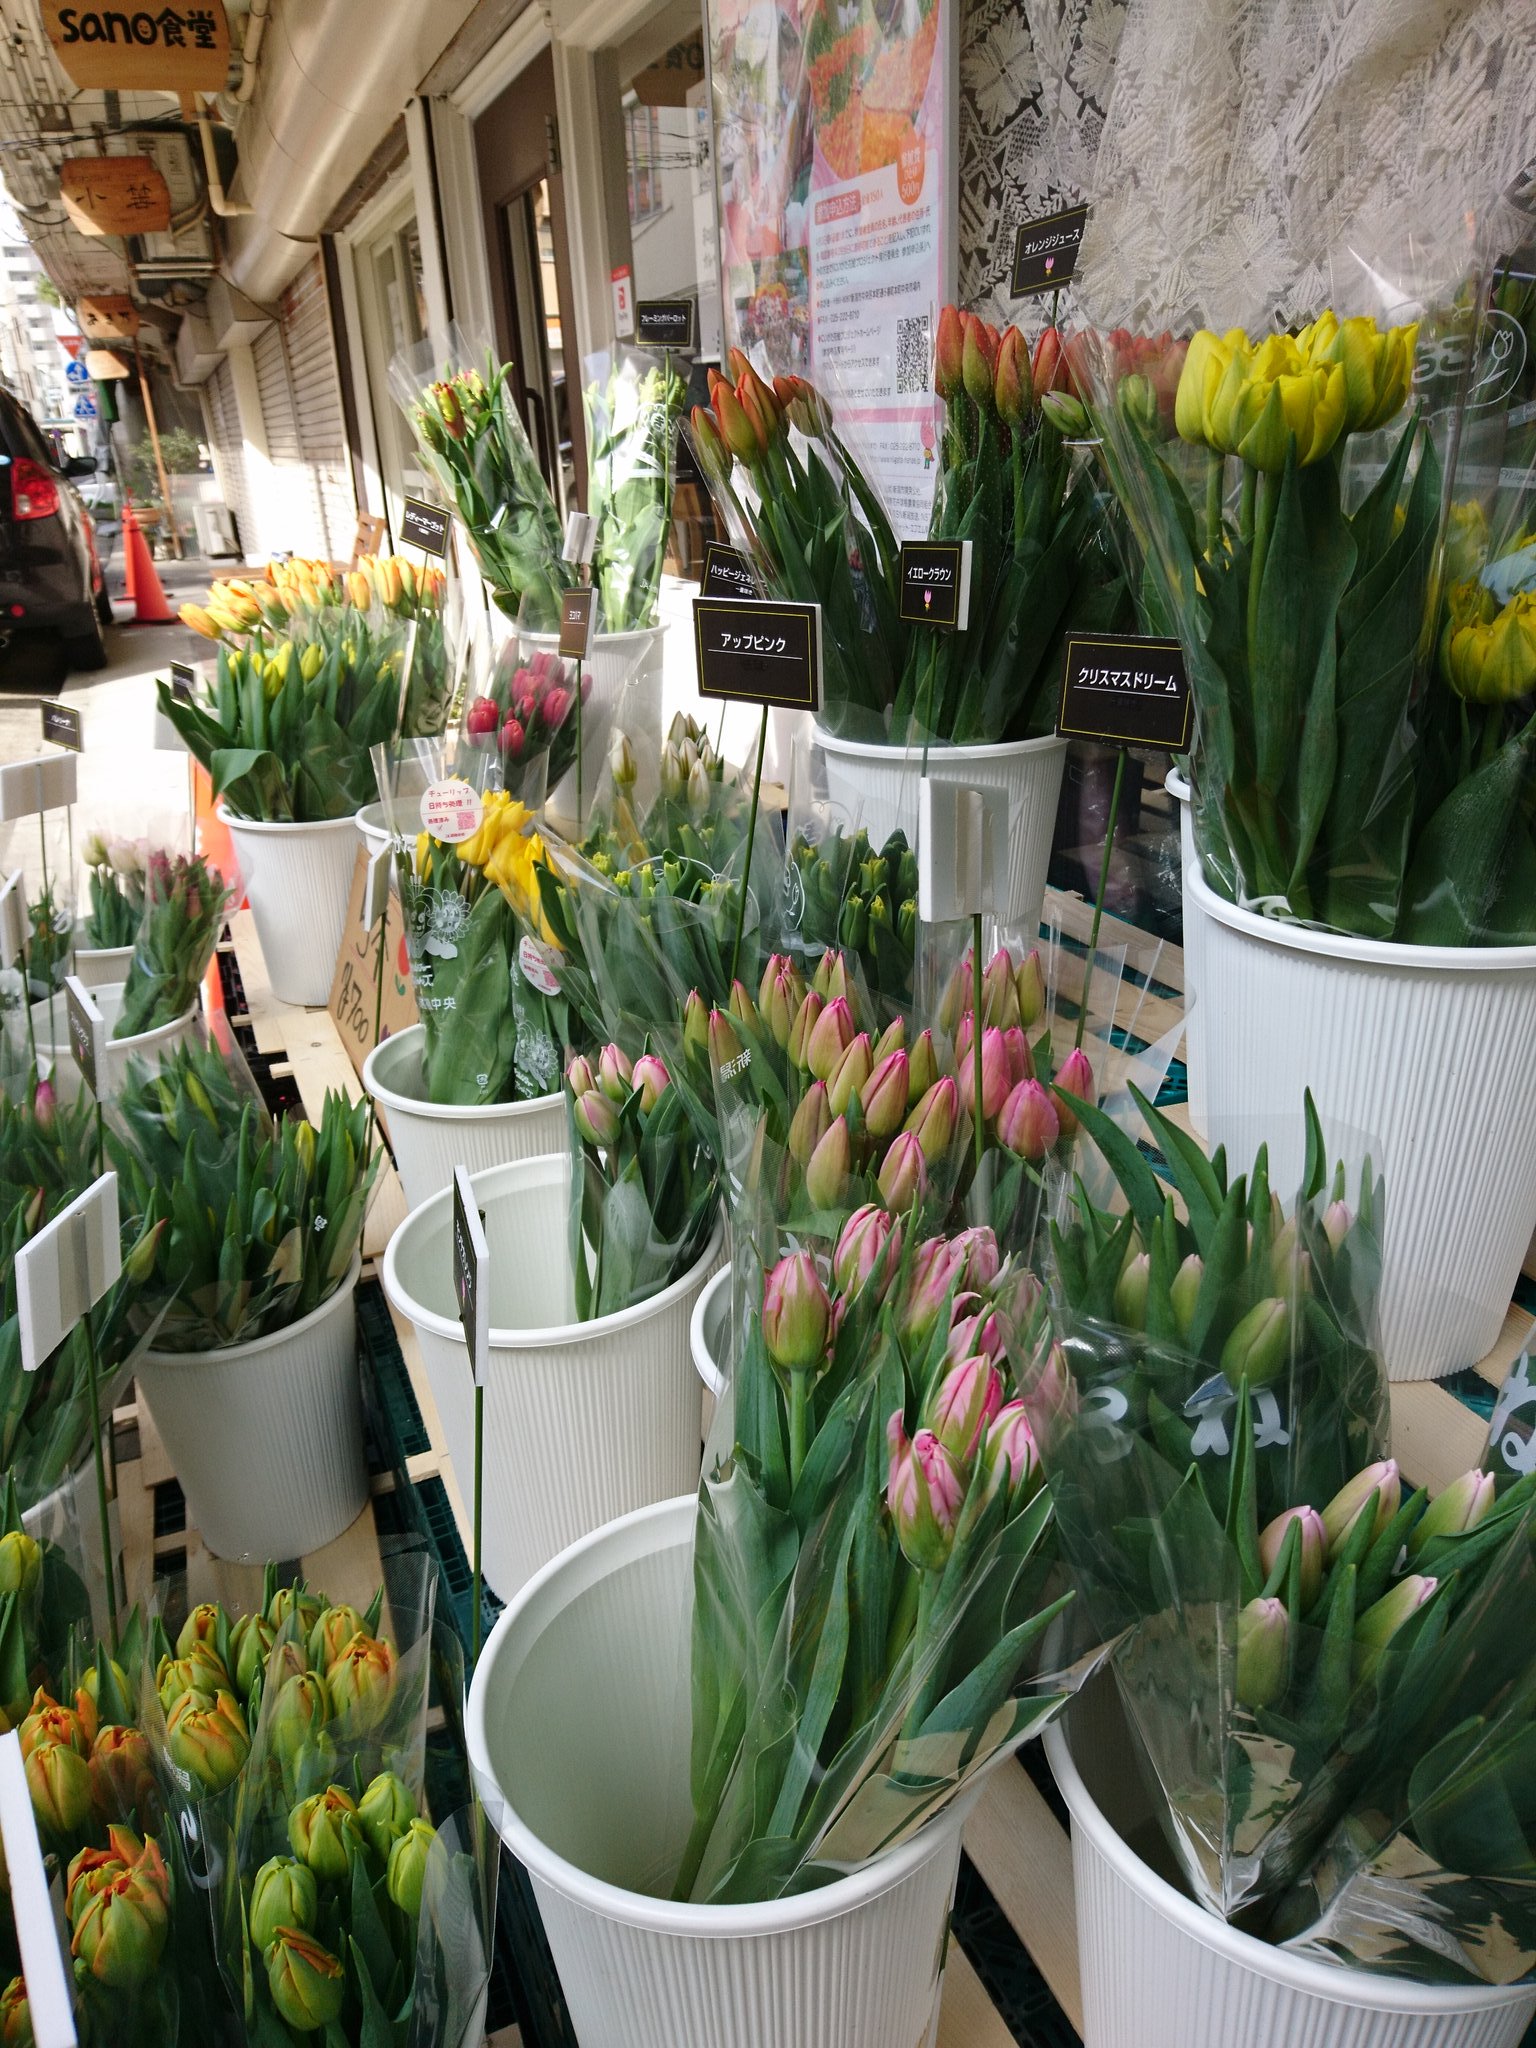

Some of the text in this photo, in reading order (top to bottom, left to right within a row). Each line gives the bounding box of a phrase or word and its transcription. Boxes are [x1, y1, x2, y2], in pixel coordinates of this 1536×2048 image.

[58, 7, 217, 49] sano食堂
[1024, 228, 1080, 255] オレンジジュース
[907, 566, 952, 581] イエロークラウン
[720, 632, 786, 653] アップピンク
[1078, 667, 1177, 693] クリスマスドリーム
